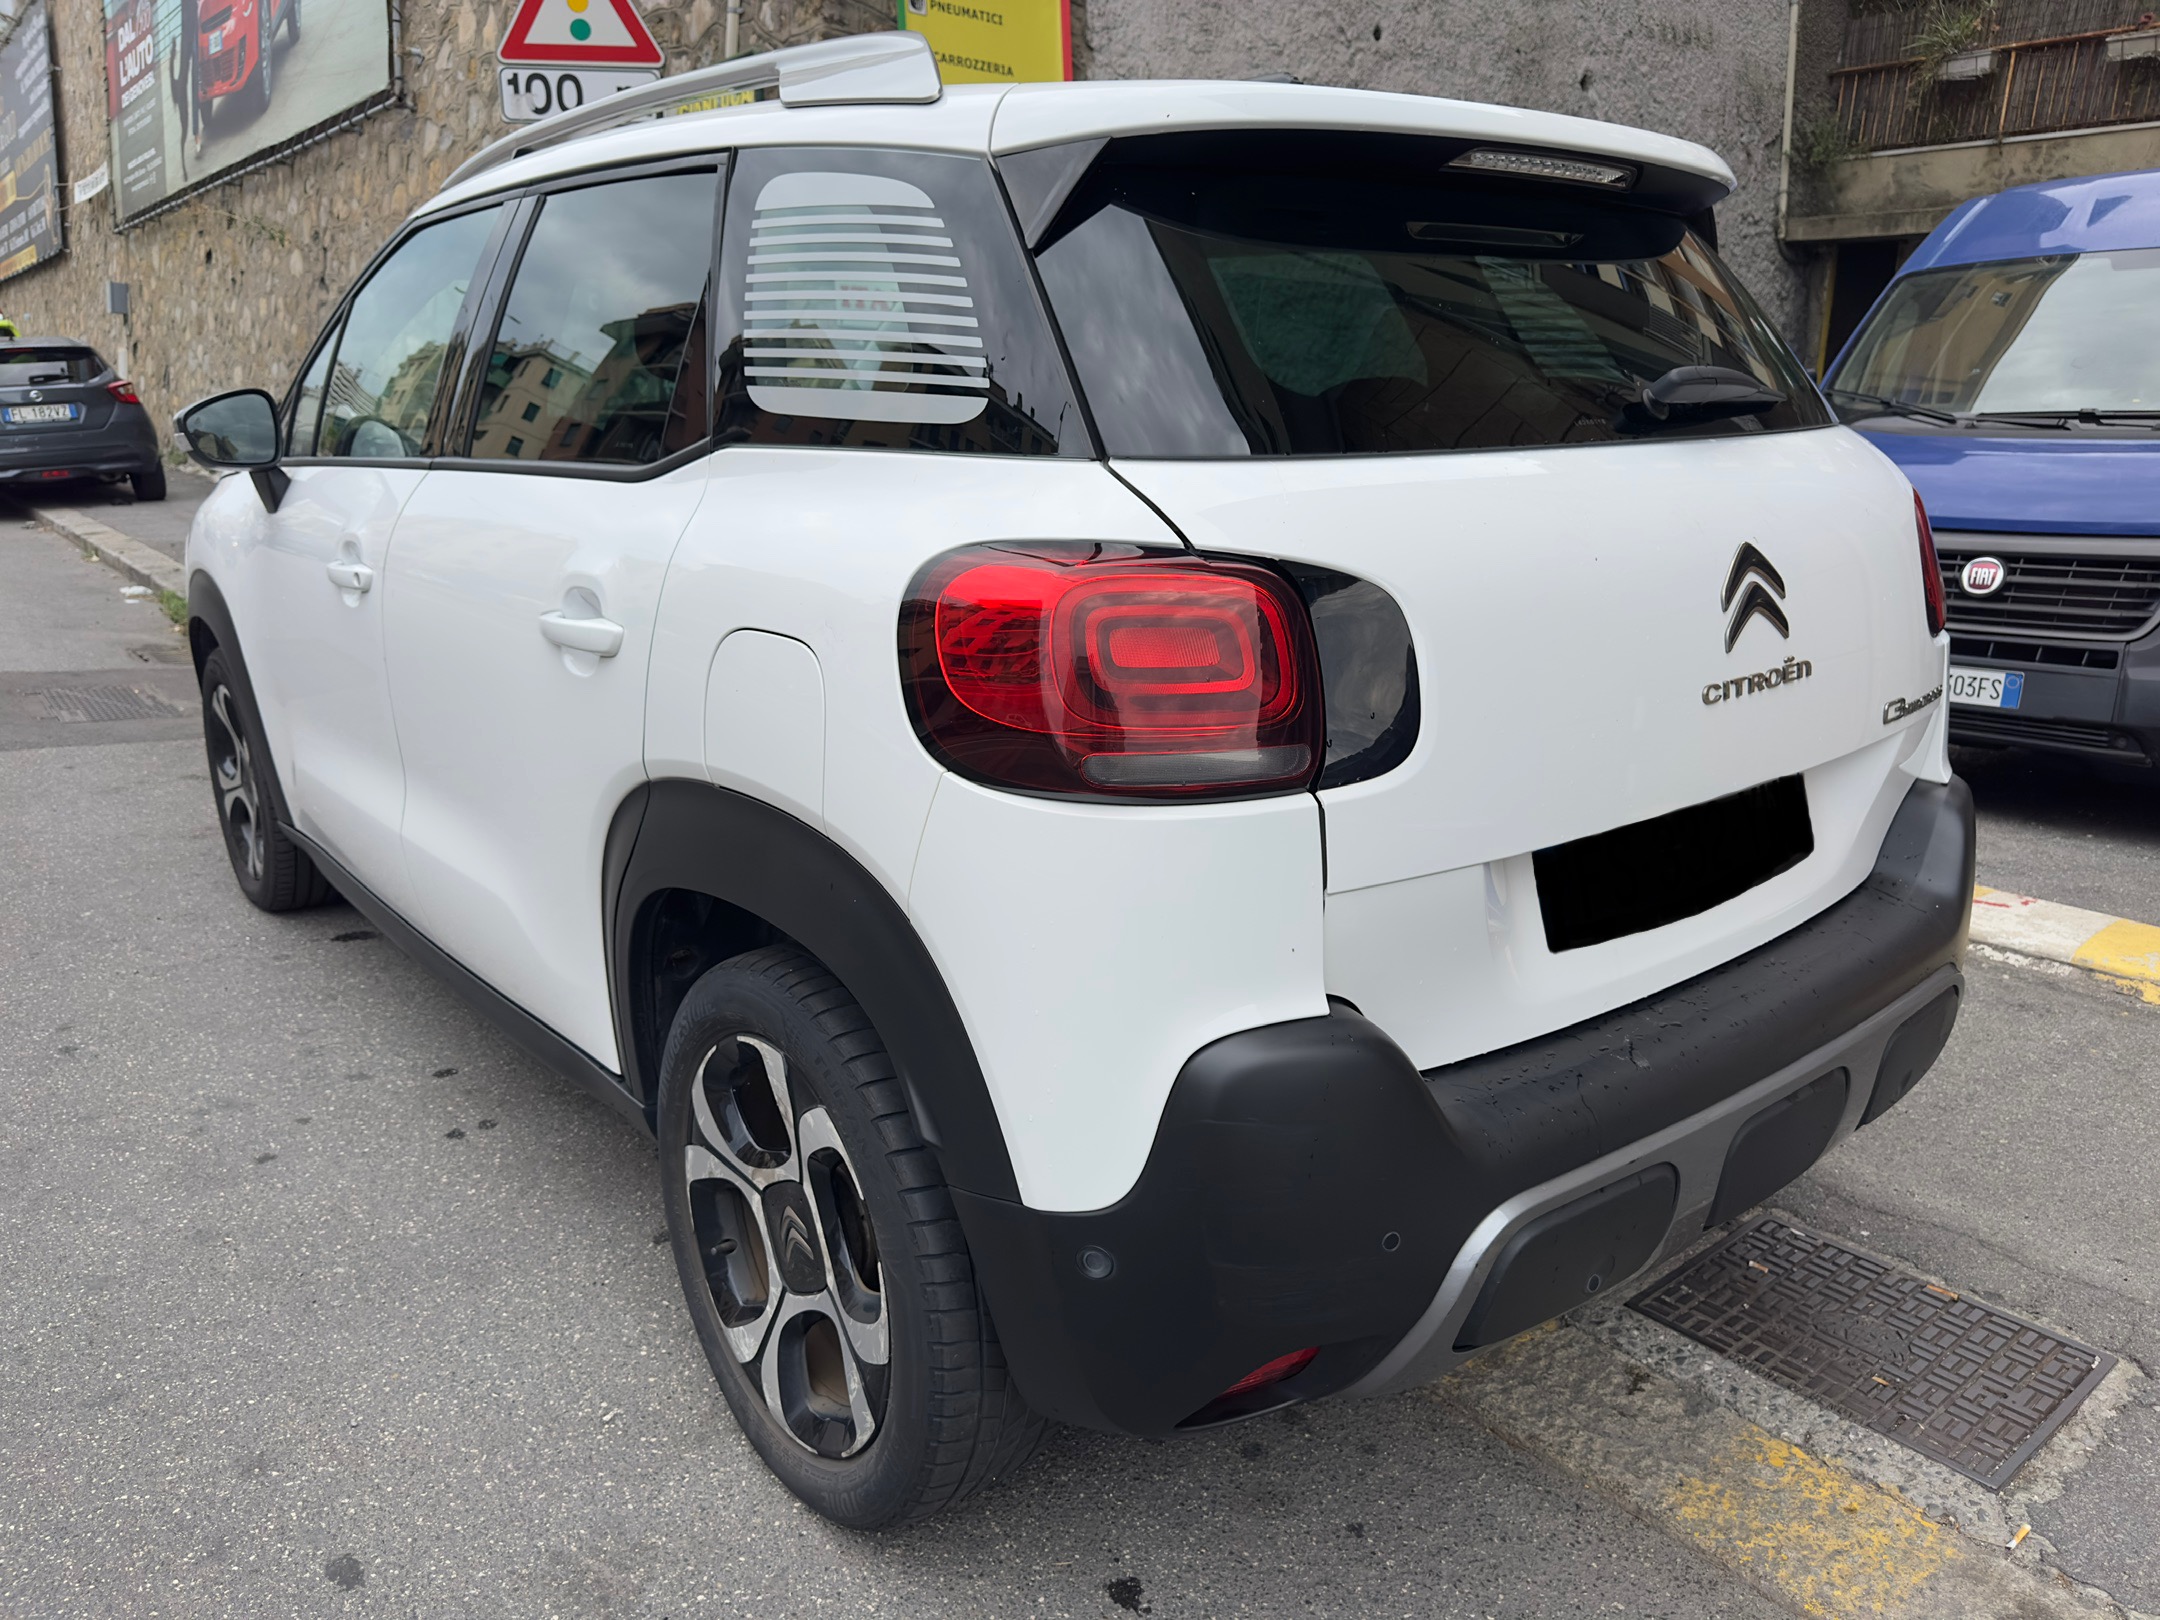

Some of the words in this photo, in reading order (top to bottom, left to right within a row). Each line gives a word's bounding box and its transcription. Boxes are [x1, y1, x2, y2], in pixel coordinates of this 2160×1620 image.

[930, 0, 1004, 25] PNEUMATICI
[934, 51, 1014, 77] CARROZZERIA
[507, 72, 583, 114] 100
[1969, 567, 1996, 586] FIAT
